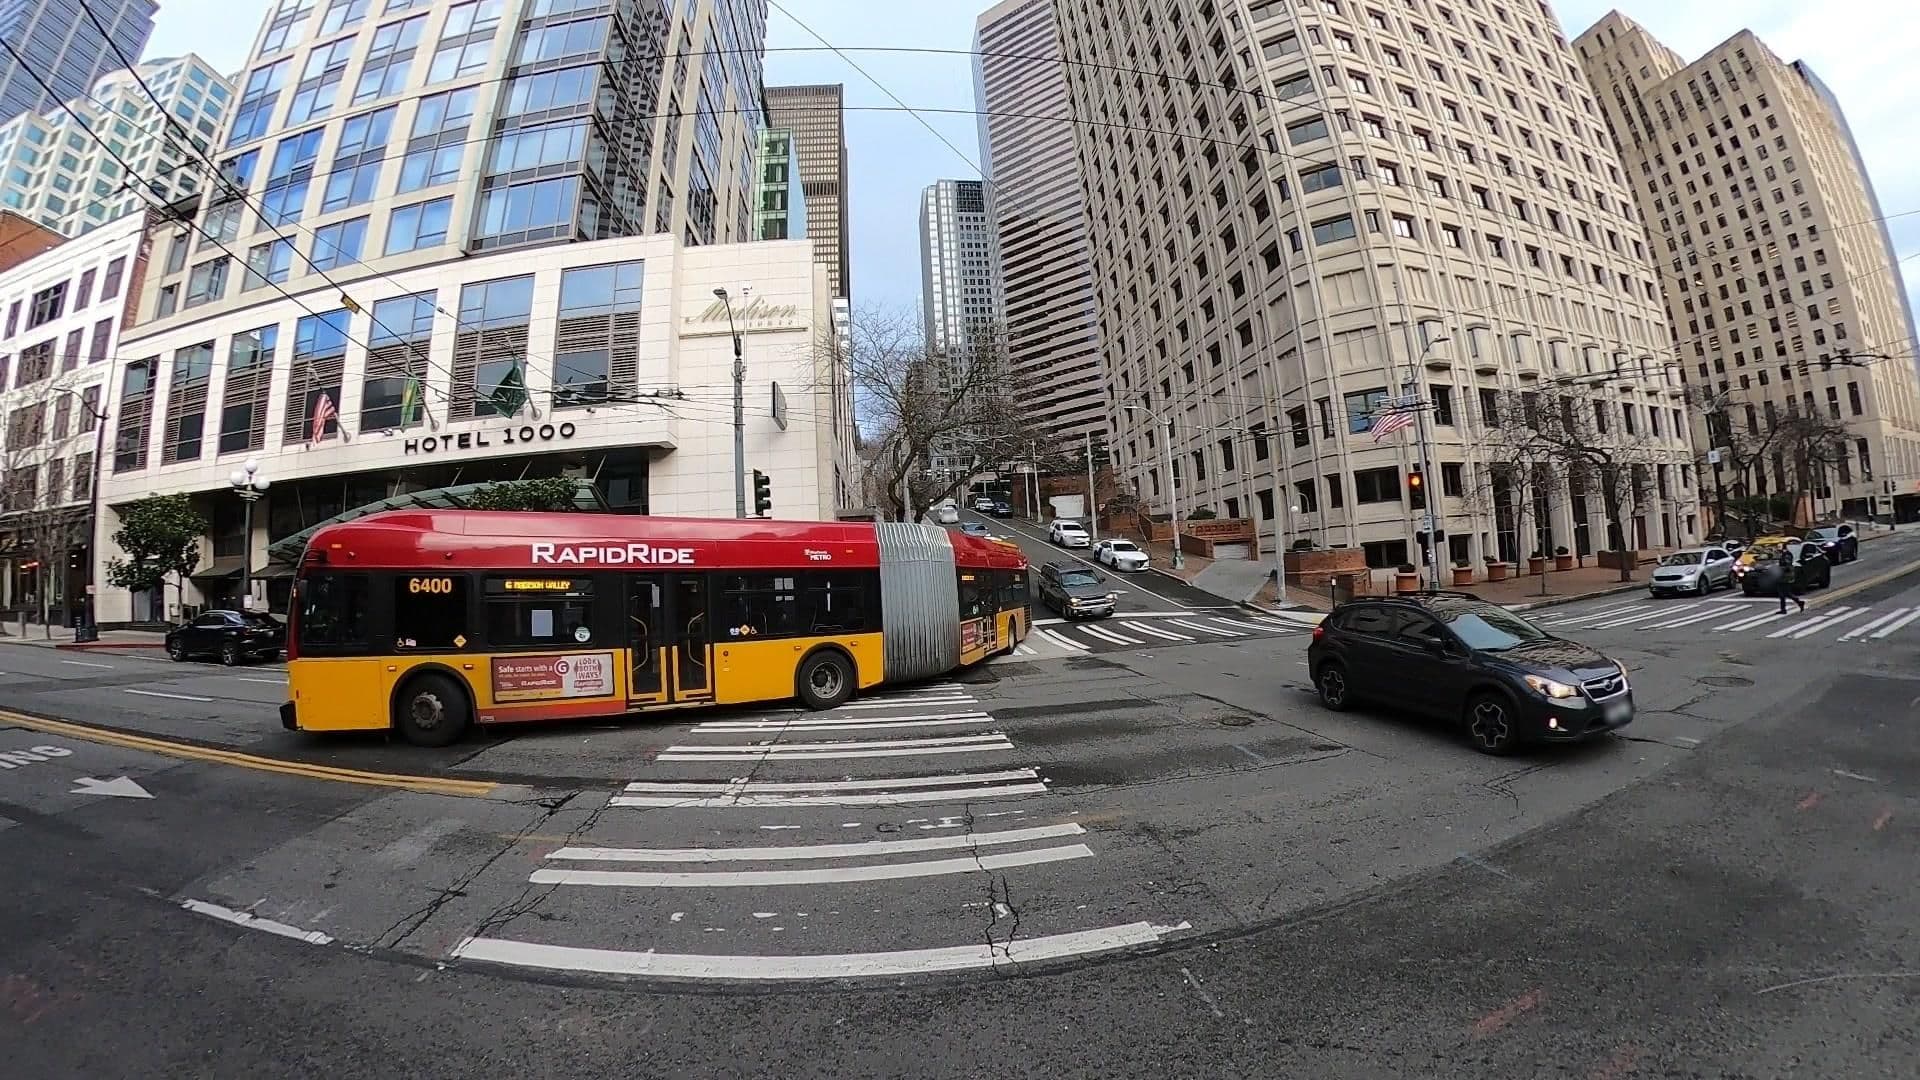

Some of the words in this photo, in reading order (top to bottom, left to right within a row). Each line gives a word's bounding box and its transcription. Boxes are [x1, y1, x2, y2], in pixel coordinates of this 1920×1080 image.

[404, 431, 490, 455] HOTEL
[503, 422, 576, 444] 1000
[409, 577, 452, 593] 6400
[498, 664, 514, 674] Safe
